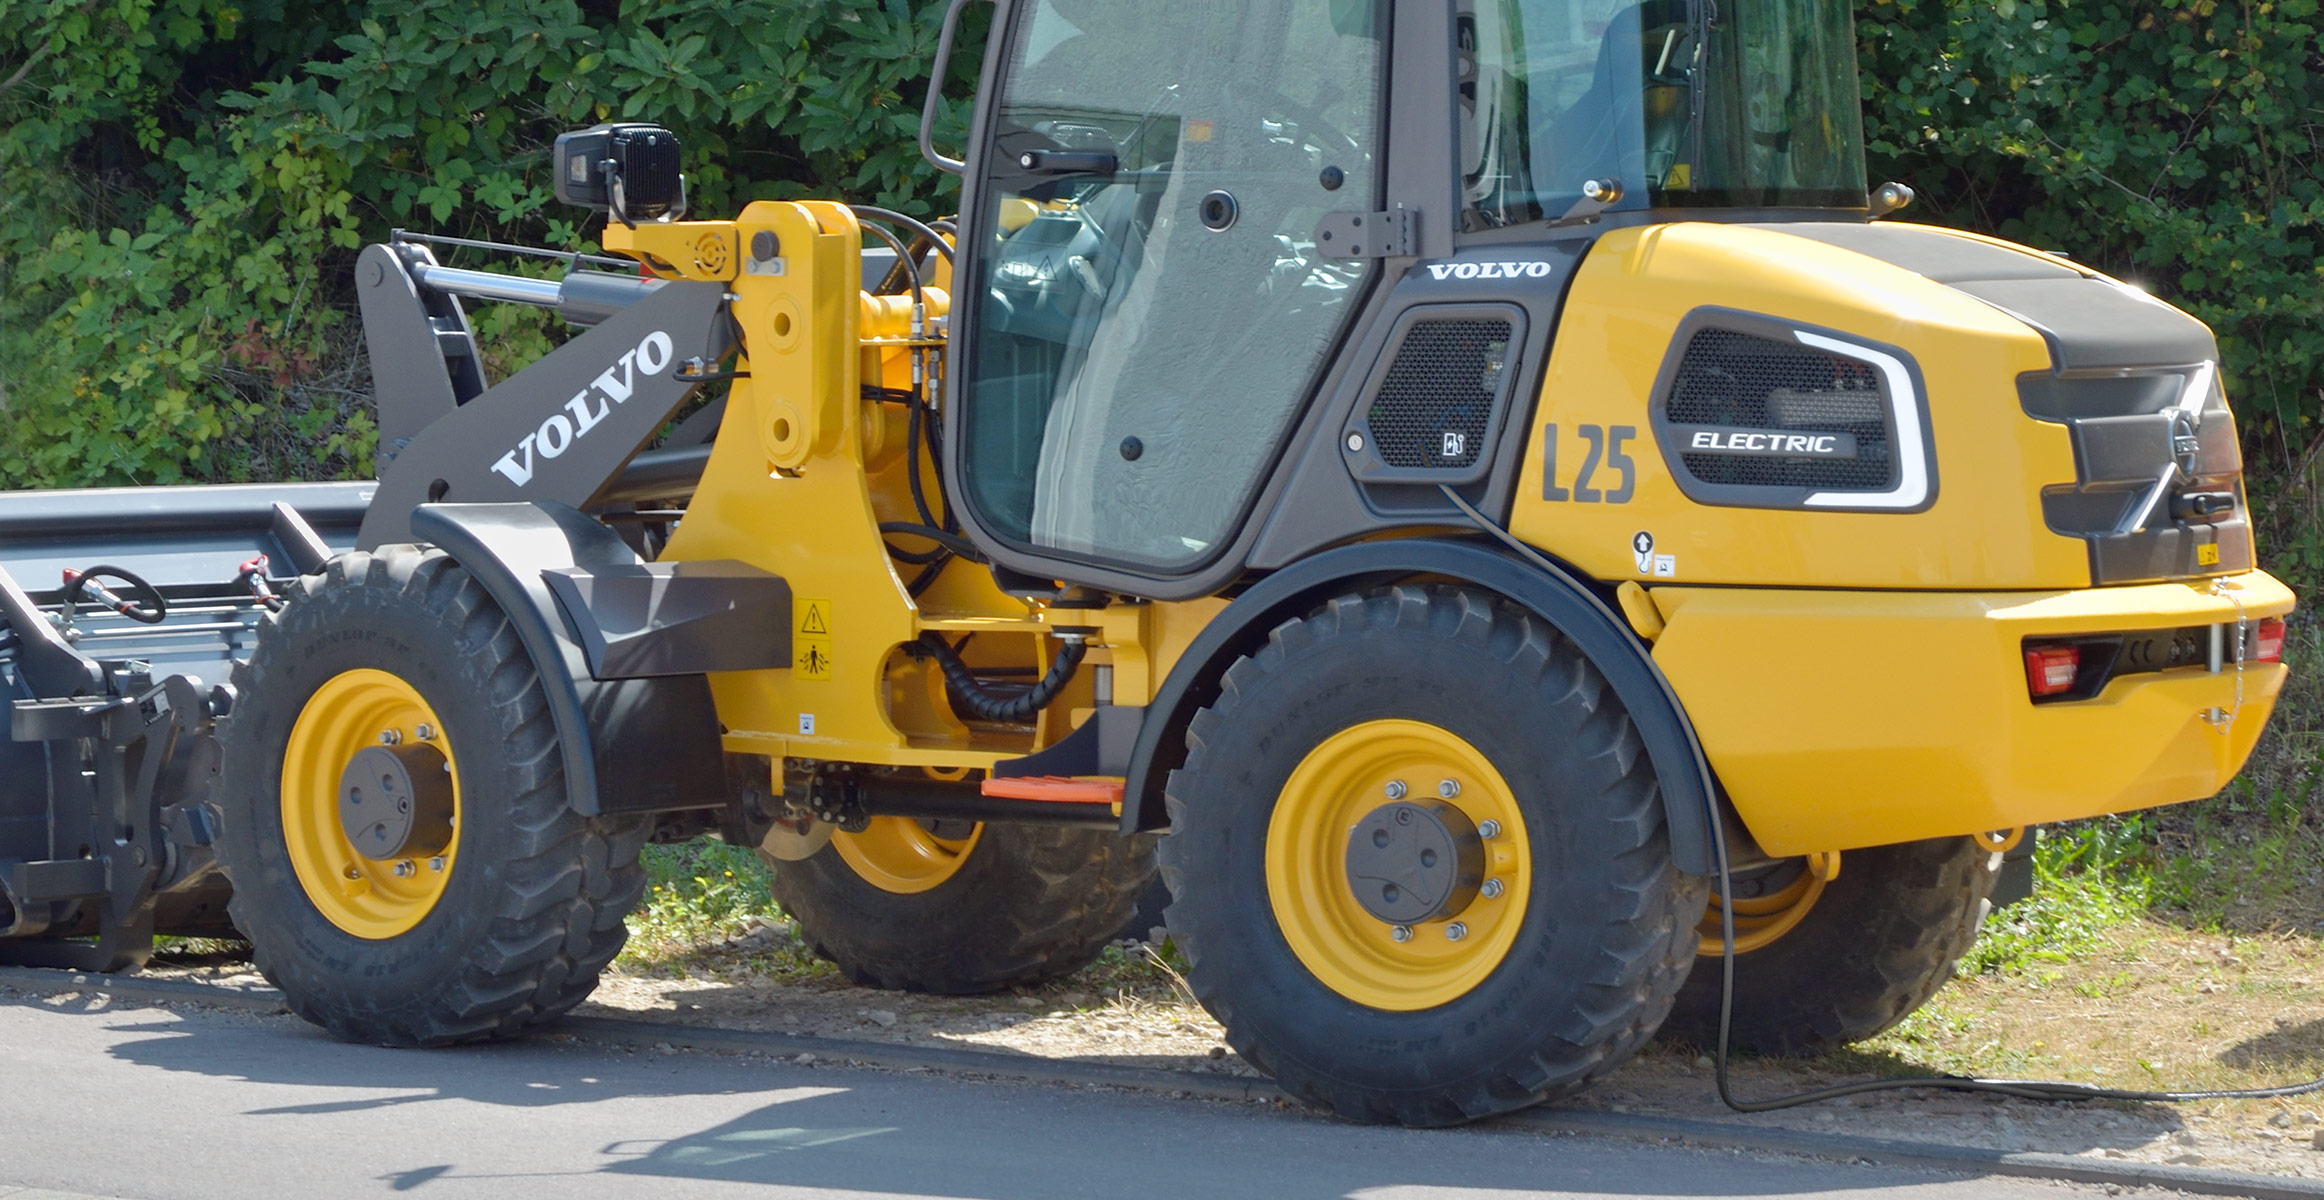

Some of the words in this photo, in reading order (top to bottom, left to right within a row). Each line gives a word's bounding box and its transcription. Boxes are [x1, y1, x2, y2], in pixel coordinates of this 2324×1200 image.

[1427, 261, 1551, 280] VOLVO
[490, 330, 674, 487] VOLVO
[1542, 424, 1636, 503] L25
[1691, 432, 1836, 453] ELECTRIC
